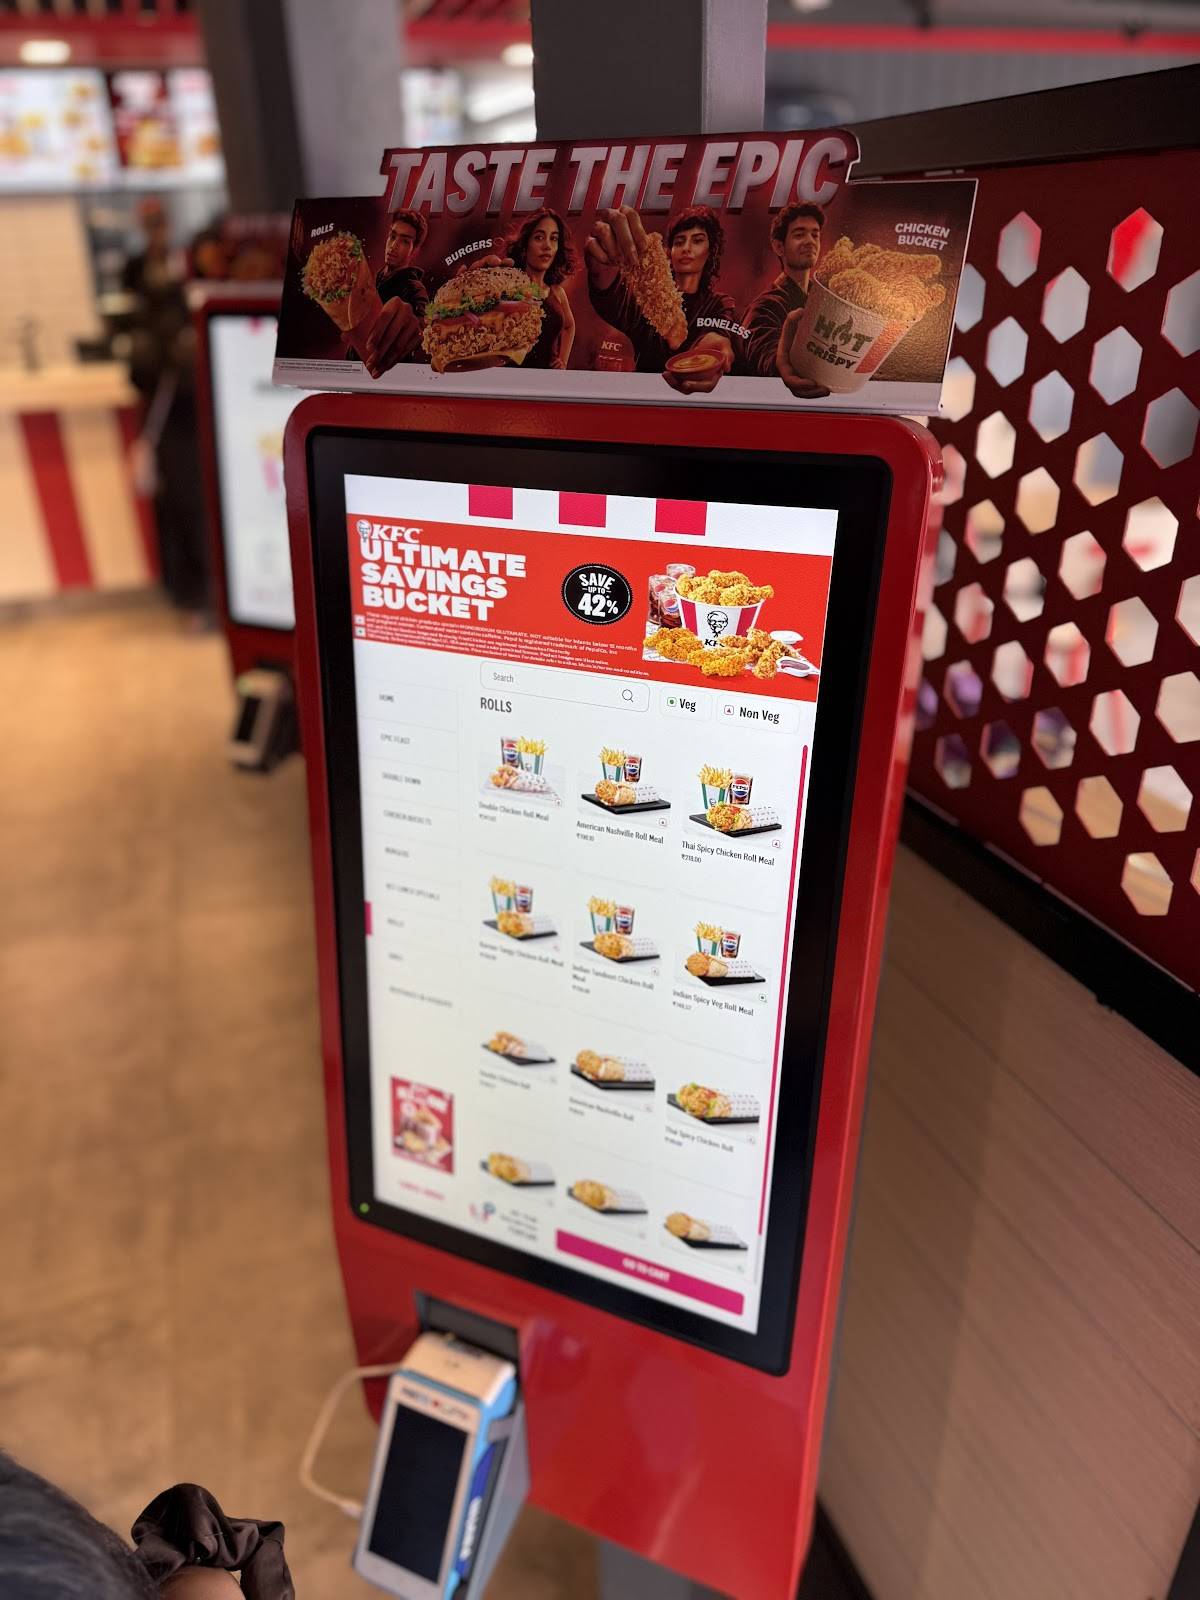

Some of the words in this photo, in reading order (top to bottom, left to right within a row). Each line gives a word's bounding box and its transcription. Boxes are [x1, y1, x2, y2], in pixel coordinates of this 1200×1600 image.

[387, 148, 557, 214] TASTE
[567, 143, 687, 211] THE
[691, 137, 848, 209] EPIC
[310, 222, 334, 238] ROLLS
[895, 222, 950, 238] CHICKEN
[444, 238, 493, 266] BURGERS
[897, 234, 948, 251] BUCKET
[696, 317, 751, 339] BONELESS
[601, 340, 622, 352] KFC
[371, 523, 422, 544] KFC
[360, 539, 527, 578] ULTIMATE
[360, 562, 508, 599] SAVINGS
[579, 573, 615, 590] SAVE
[588, 586, 596, 594] UP
[362, 584, 495, 621] BUCKET
[493, 672, 514, 683] Search
[480, 696, 512, 713] ROLLS
[680, 698, 696, 712] Veg
[740, 706, 759, 719] Non
[762, 710, 780, 724] Veg
[576, 820, 605, 832] American
[606, 826, 634, 838] Nashville
[635, 831, 648, 840] Roll
[649, 834, 664, 844] Meal
[682, 840, 696, 850] Thai
[696, 844, 715, 855] Spicy
[716, 848, 742, 860] Chicken
[744, 852, 757, 863] Roll
[758, 855, 775, 866] Meal
[672, 990, 692, 1000] Indian
[693, 991, 710, 1006] Spicy
[711, 999, 723, 1010] Veg
[724, 1002, 737, 1012] Roll
[738, 1006, 754, 1017] Meal
